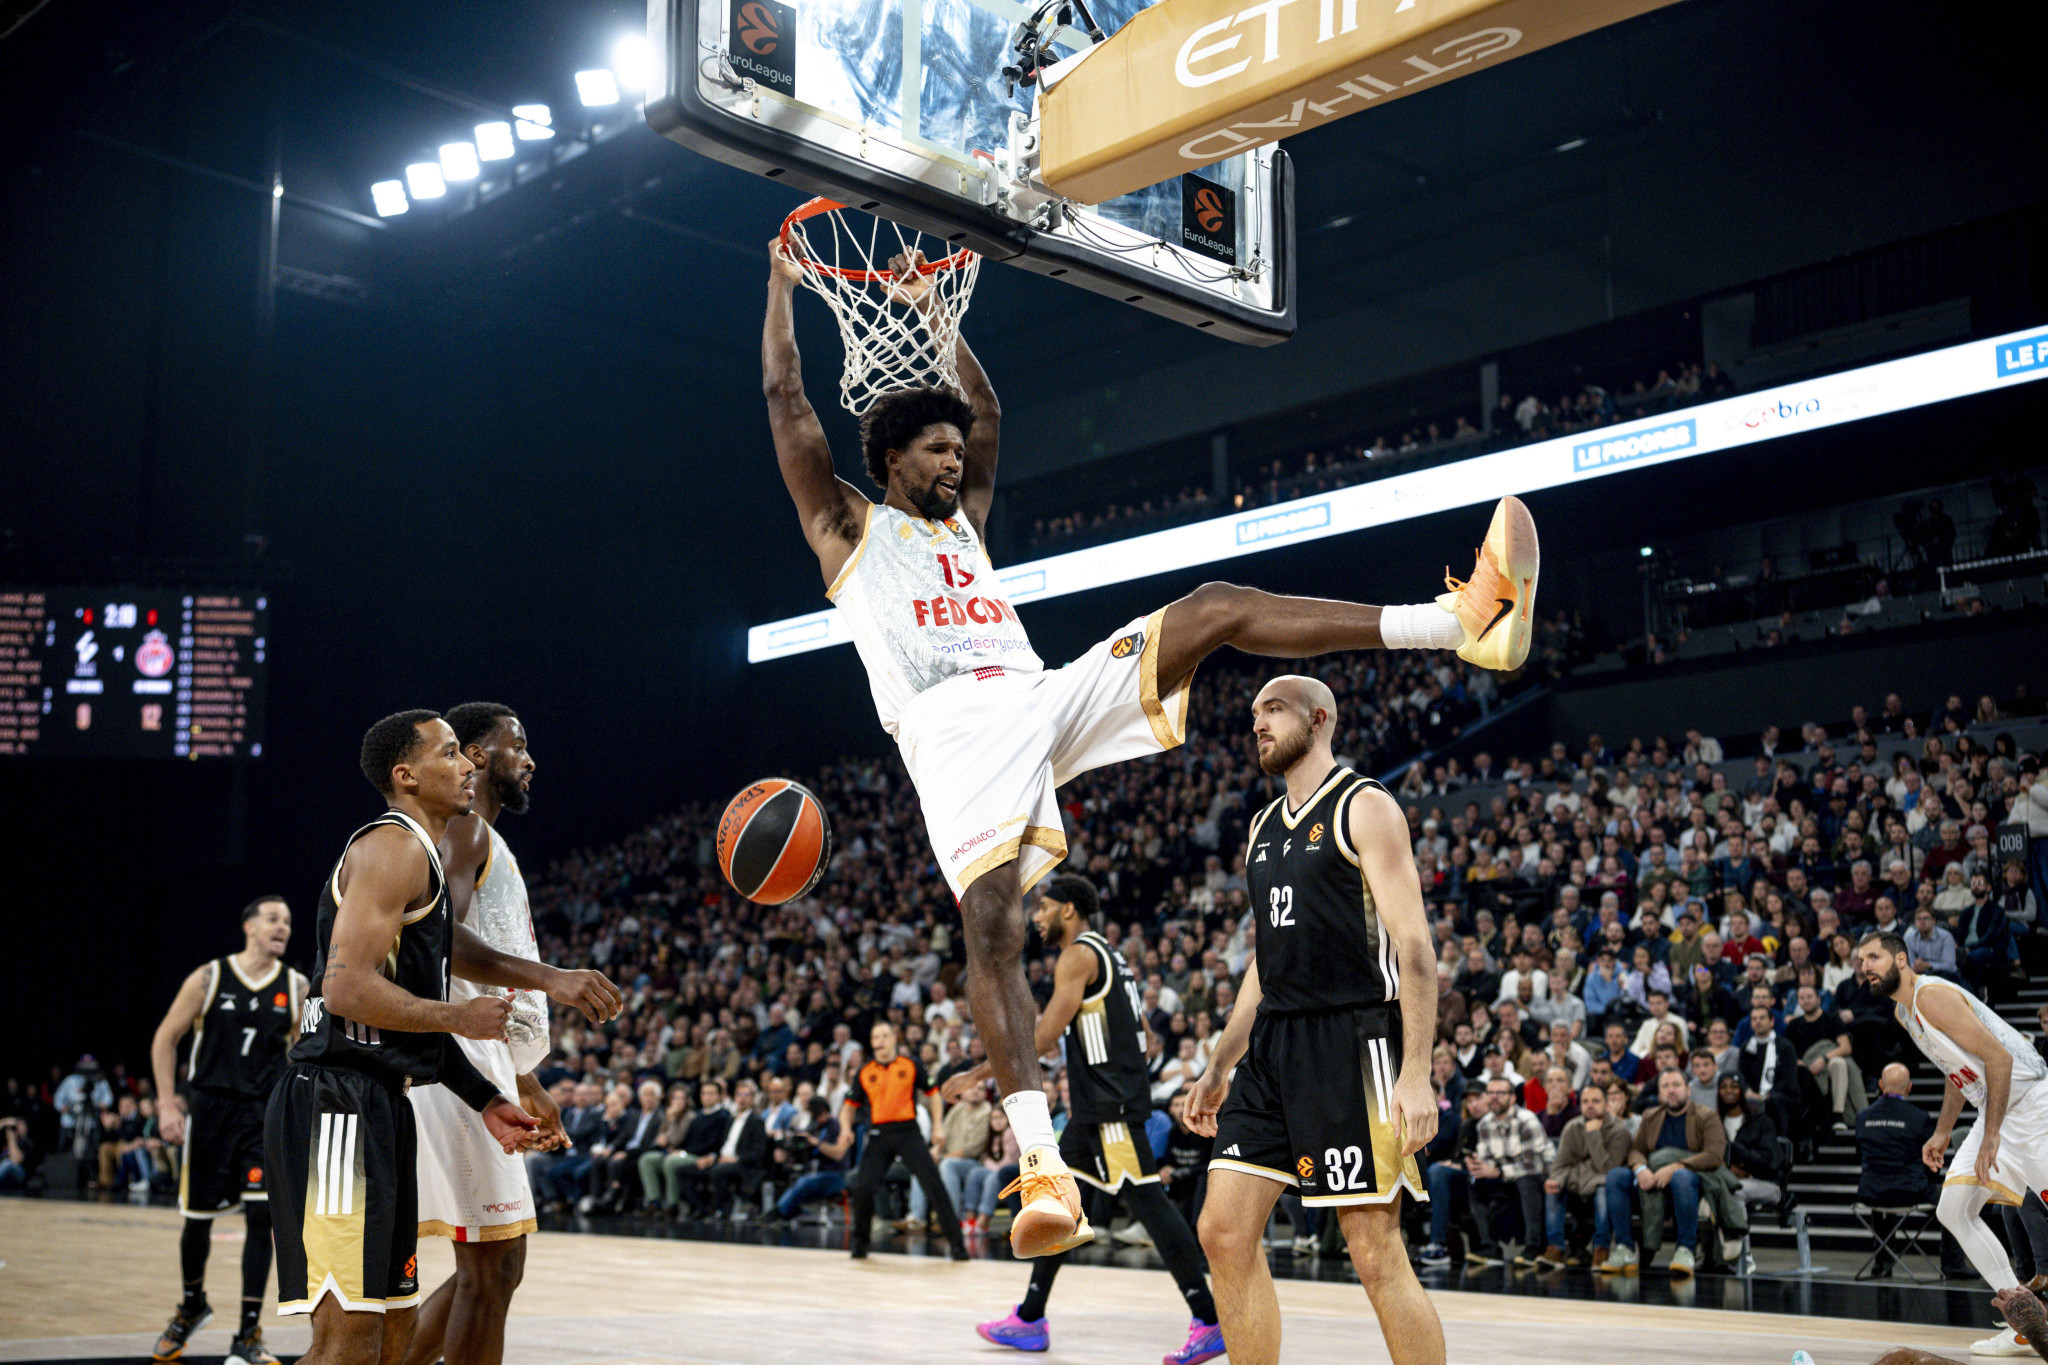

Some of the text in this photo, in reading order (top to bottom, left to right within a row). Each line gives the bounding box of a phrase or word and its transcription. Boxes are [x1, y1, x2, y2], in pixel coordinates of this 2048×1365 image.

[728, 52, 792, 85] uroLeague
[1178, 27, 1523, 160] ETIHAD
[1184, 227, 1234, 256] EuroLeague
[2005, 344, 2035, 371] LE
[717, 784, 766, 864] SPALDING
[2000, 833, 2023, 852] 008
[1269, 885, 1296, 928] 32
[241, 1027, 257, 1057] 7
[1324, 1145, 1368, 1192] 32
